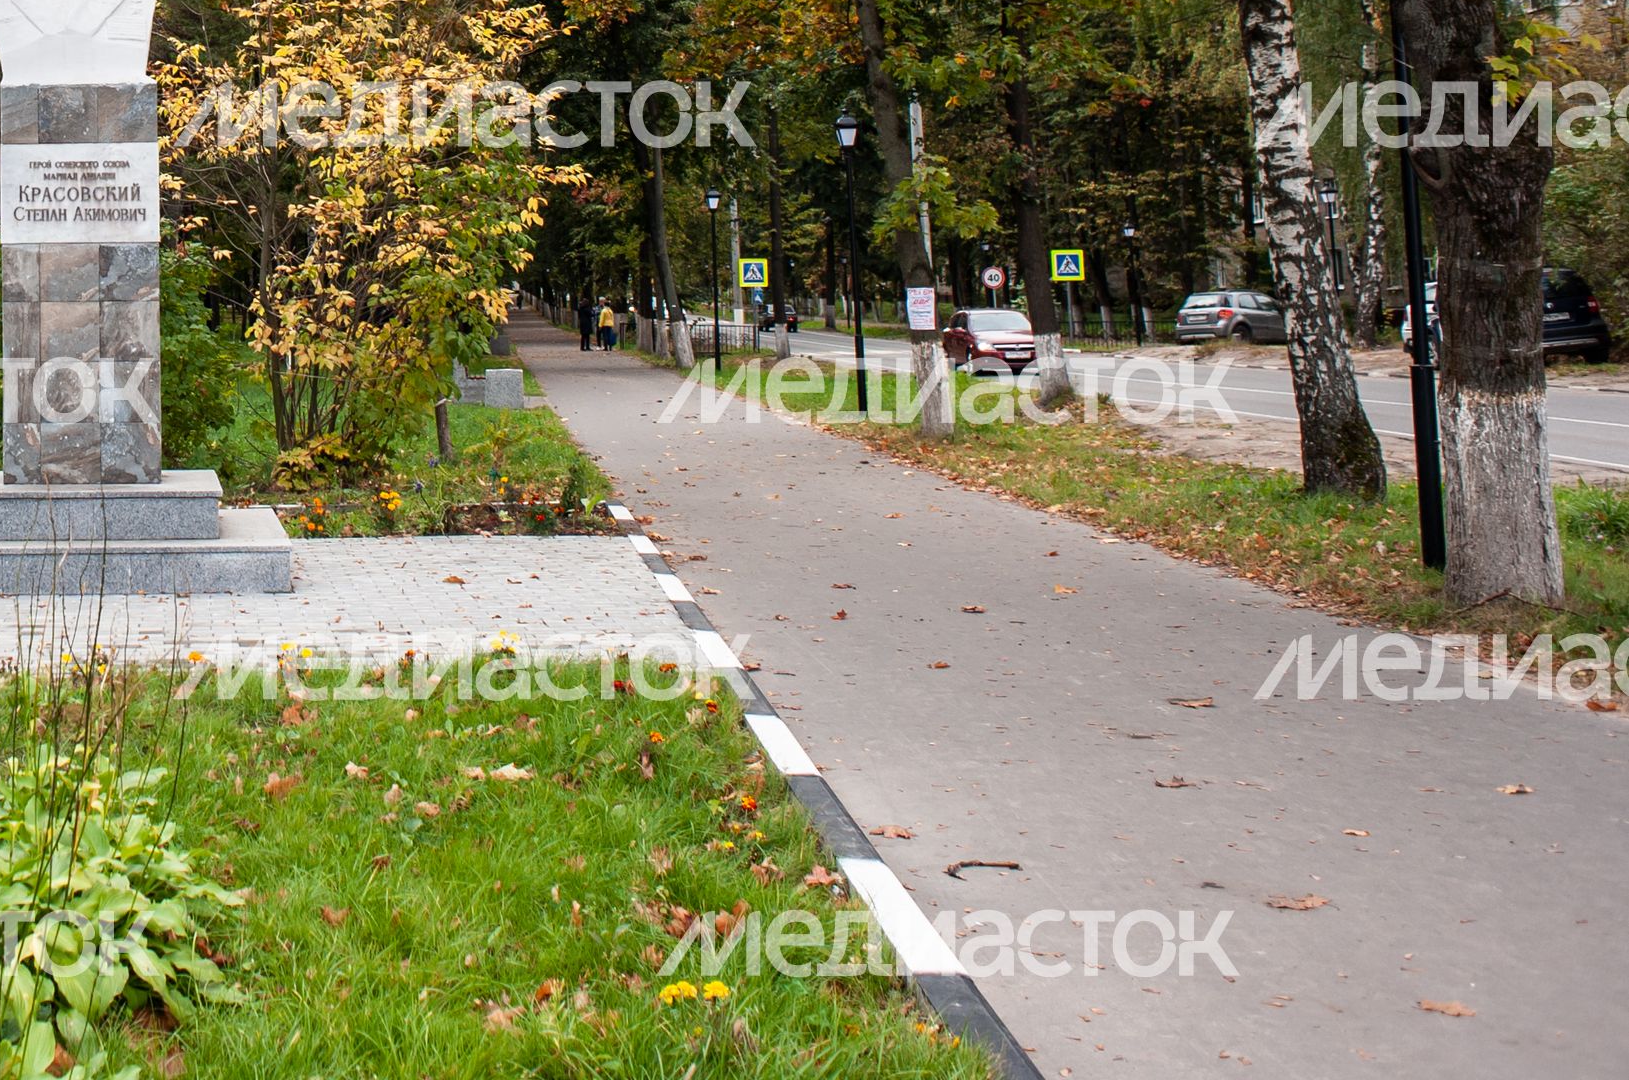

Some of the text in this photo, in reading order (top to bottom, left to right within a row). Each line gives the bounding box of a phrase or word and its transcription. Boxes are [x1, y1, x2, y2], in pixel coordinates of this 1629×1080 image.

[29, 160, 51, 168] ГЕРОЙ
[19, 183, 141, 202] КРАСОВСКИЙ
[13, 206, 146, 221] СТЕПАН АКИМОВИЧ
[987, 274, 1000, 282] 40
